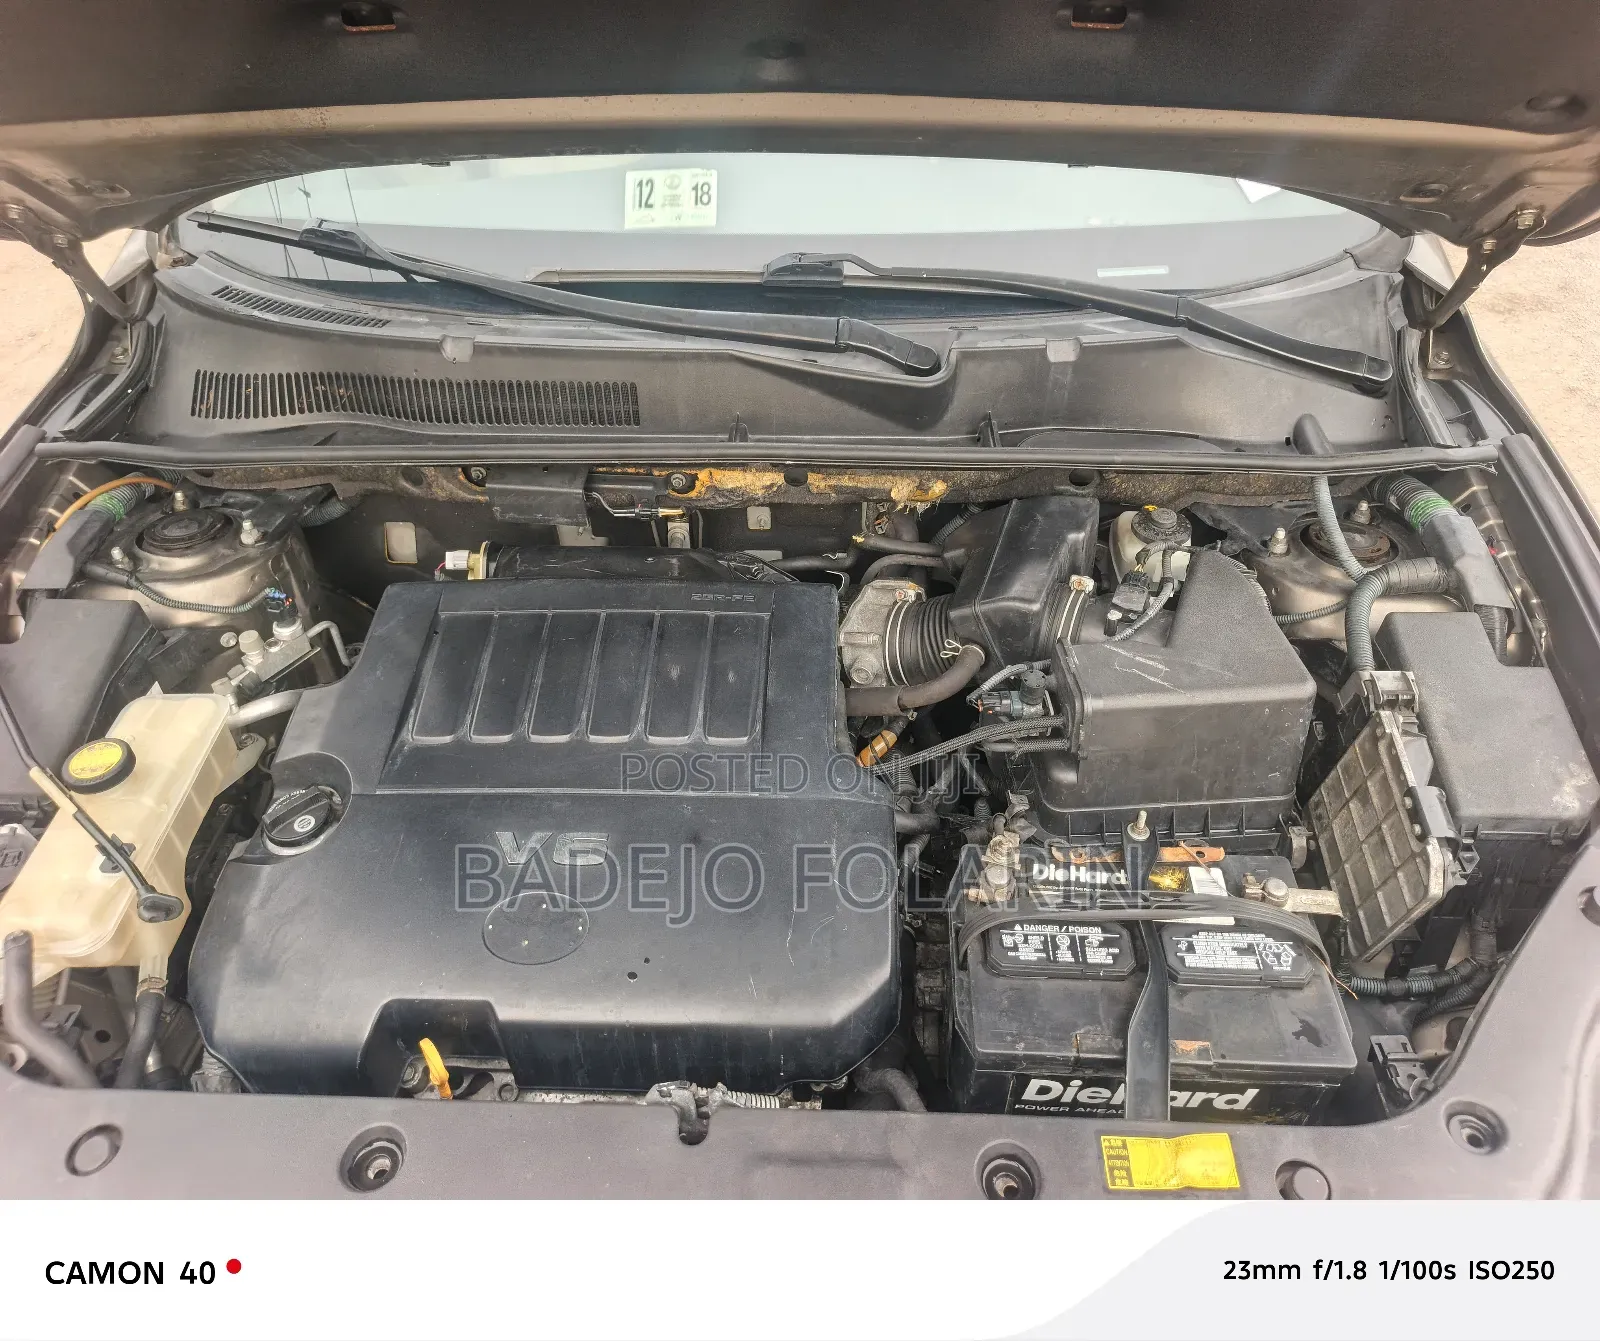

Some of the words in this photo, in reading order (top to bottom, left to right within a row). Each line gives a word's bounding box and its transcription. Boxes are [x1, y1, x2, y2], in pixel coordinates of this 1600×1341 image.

[636, 178, 655, 209] 12
[691, 181, 711, 206] 18
[495, 831, 610, 866] V6
[1032, 863, 1129, 885] DieHard
[1023, 924, 1060, 933] DANGER
[1068, 925, 1102, 934] POISON
[1021, 1078, 1260, 1110] Dieard
[1014, 1104, 1070, 1113] POWER
